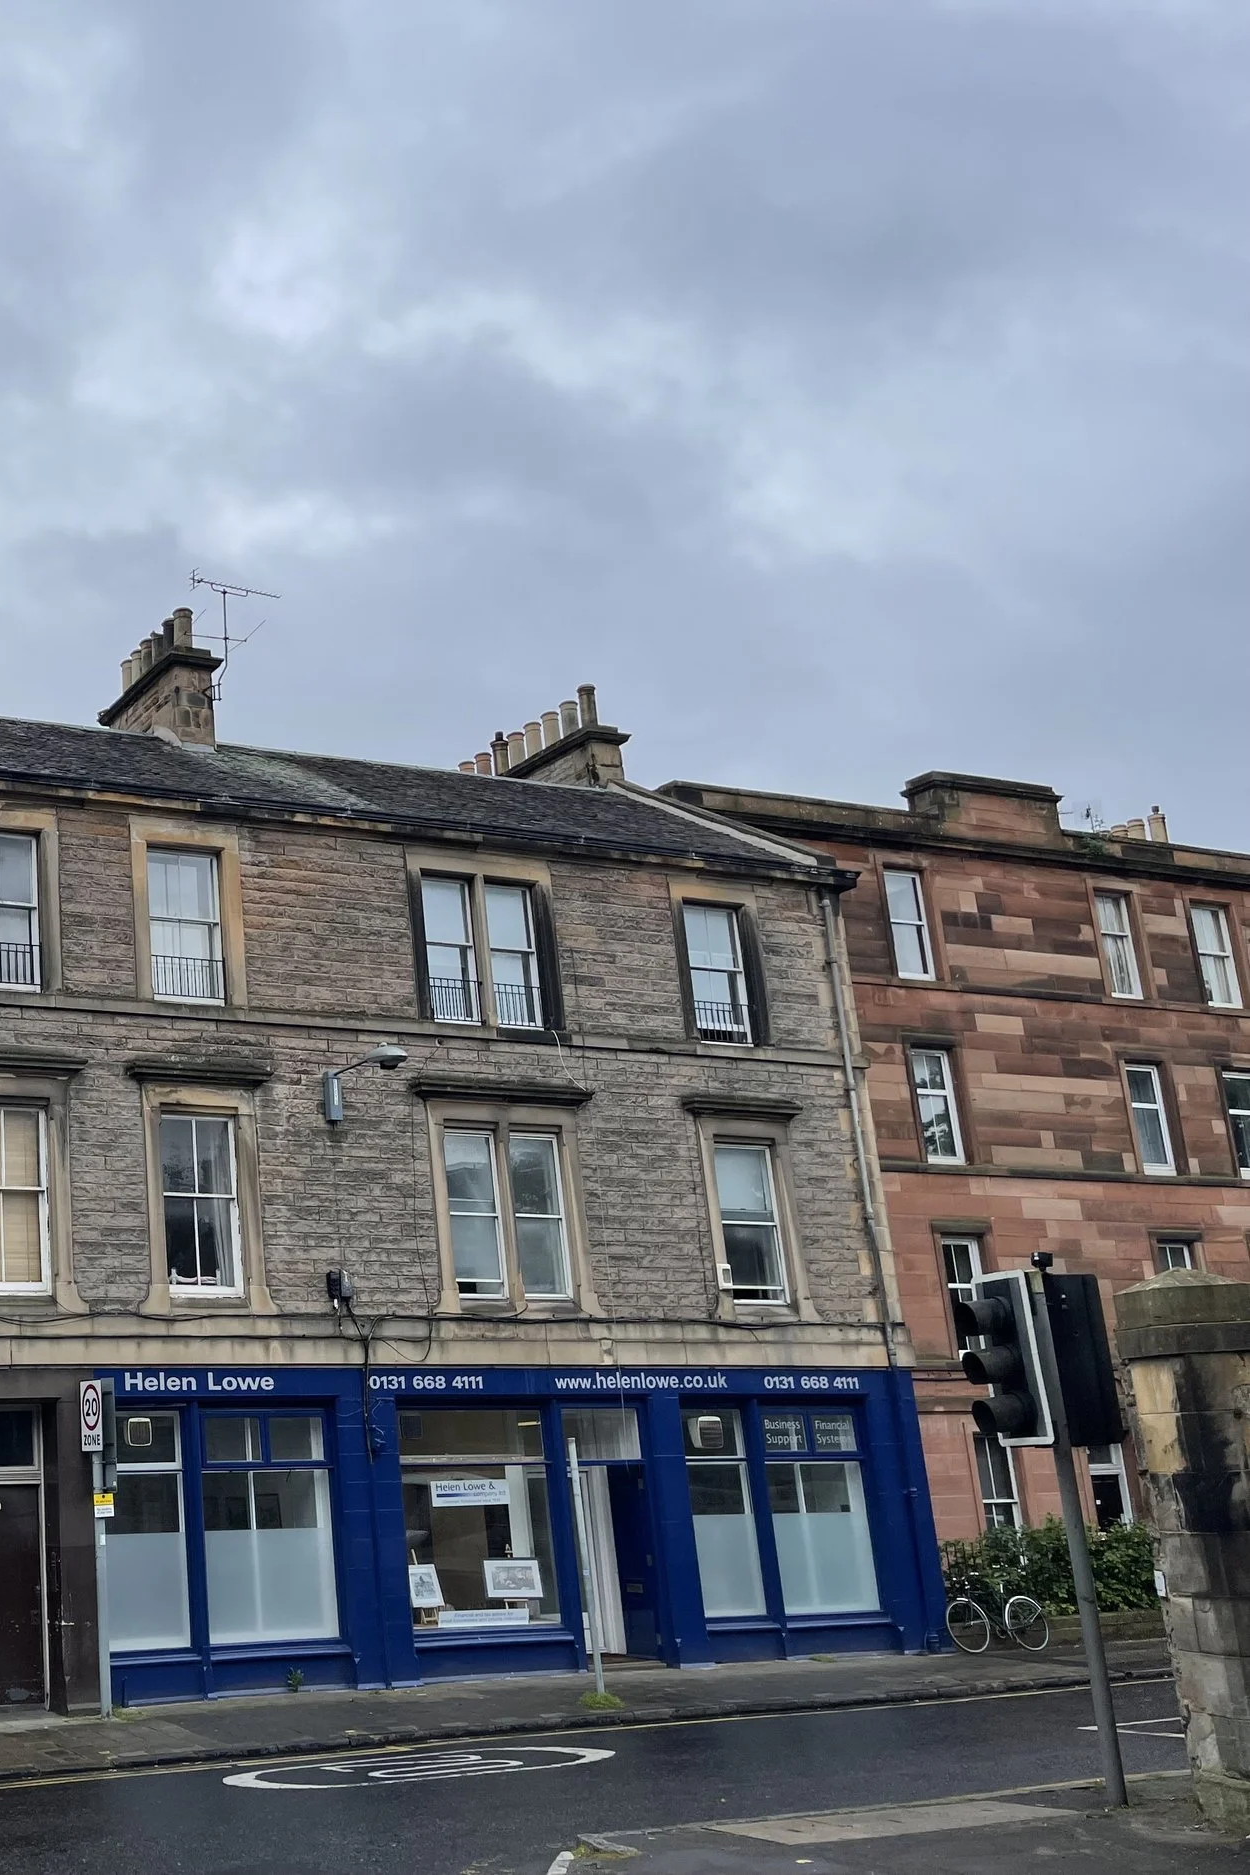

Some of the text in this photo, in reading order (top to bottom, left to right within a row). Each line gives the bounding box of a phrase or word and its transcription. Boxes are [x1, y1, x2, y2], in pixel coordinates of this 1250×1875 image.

[124, 1371, 275, 1391] Helen Lowe
[369, 1375, 484, 1389] 0131 668 4111
[554, 1371, 728, 1389] www.helenlowe.co.uk
[763, 1376, 860, 1390] 0131 668 4111
[85, 1397, 98, 1417] 20
[764, 1419, 801, 1430] Business
[814, 1420, 850, 1430] Financial
[83, 1434, 101, 1446] ZONE
[766, 1433, 803, 1446] Support
[435, 1481, 496, 1491] Helen Lowe &
